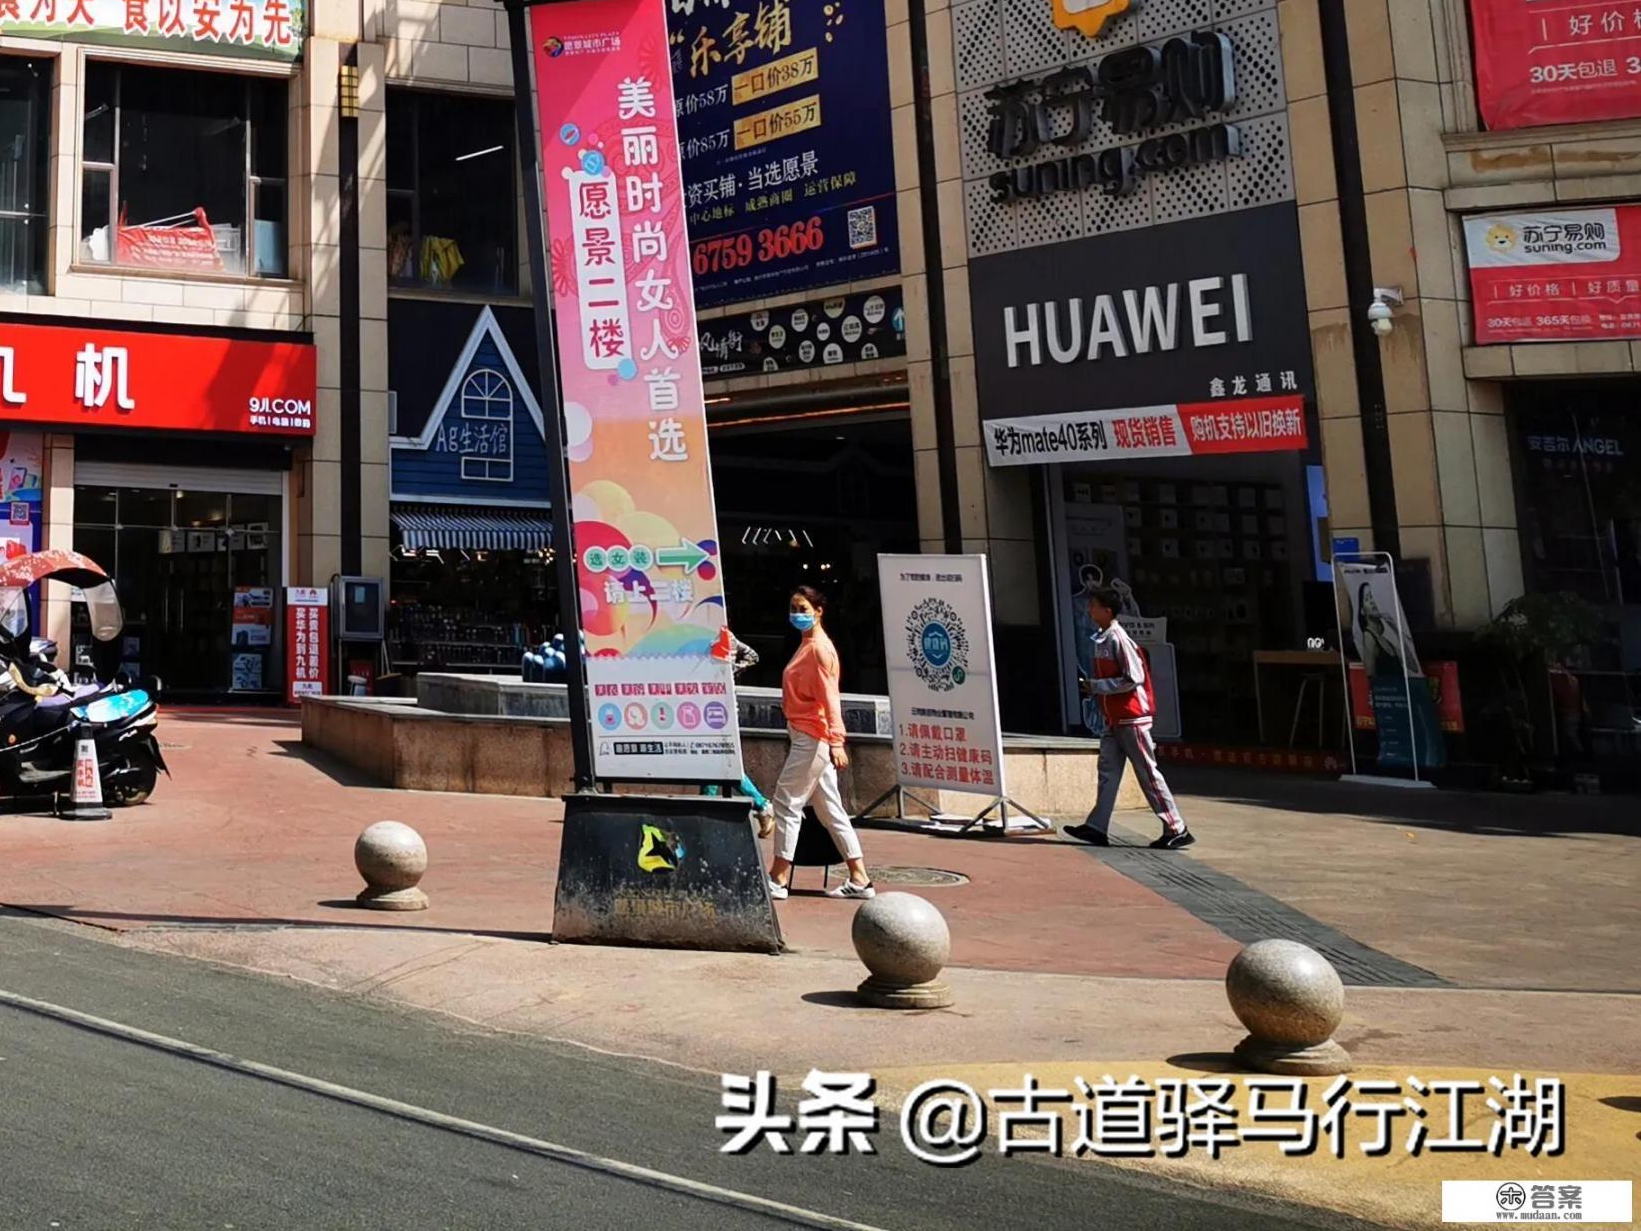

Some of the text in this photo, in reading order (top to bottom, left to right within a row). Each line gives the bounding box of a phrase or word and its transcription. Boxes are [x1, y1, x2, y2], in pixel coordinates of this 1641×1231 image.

[1528, 59, 1619, 84] 30天包退
[684, 150, 819, 209] 资买铺·当选愿景
[692, 233, 753, 276] 6759
[758, 215, 825, 263] 3666
[1522, 222, 1606, 244] 苏宁易购
[1523, 240, 1607, 254] suning.com
[577, 179, 627, 359] 愿景二楼
[616, 74, 689, 463] 美丽时尚女人首选
[1003, 272, 1254, 368] HUAWEI
[1209, 370, 1298, 398] 鑫龙通讯
[435, 421, 508, 455] Ag生活馆
[994, 407, 1303, 457] 华为mate40系列 现货销售 购机支持以旧换新
